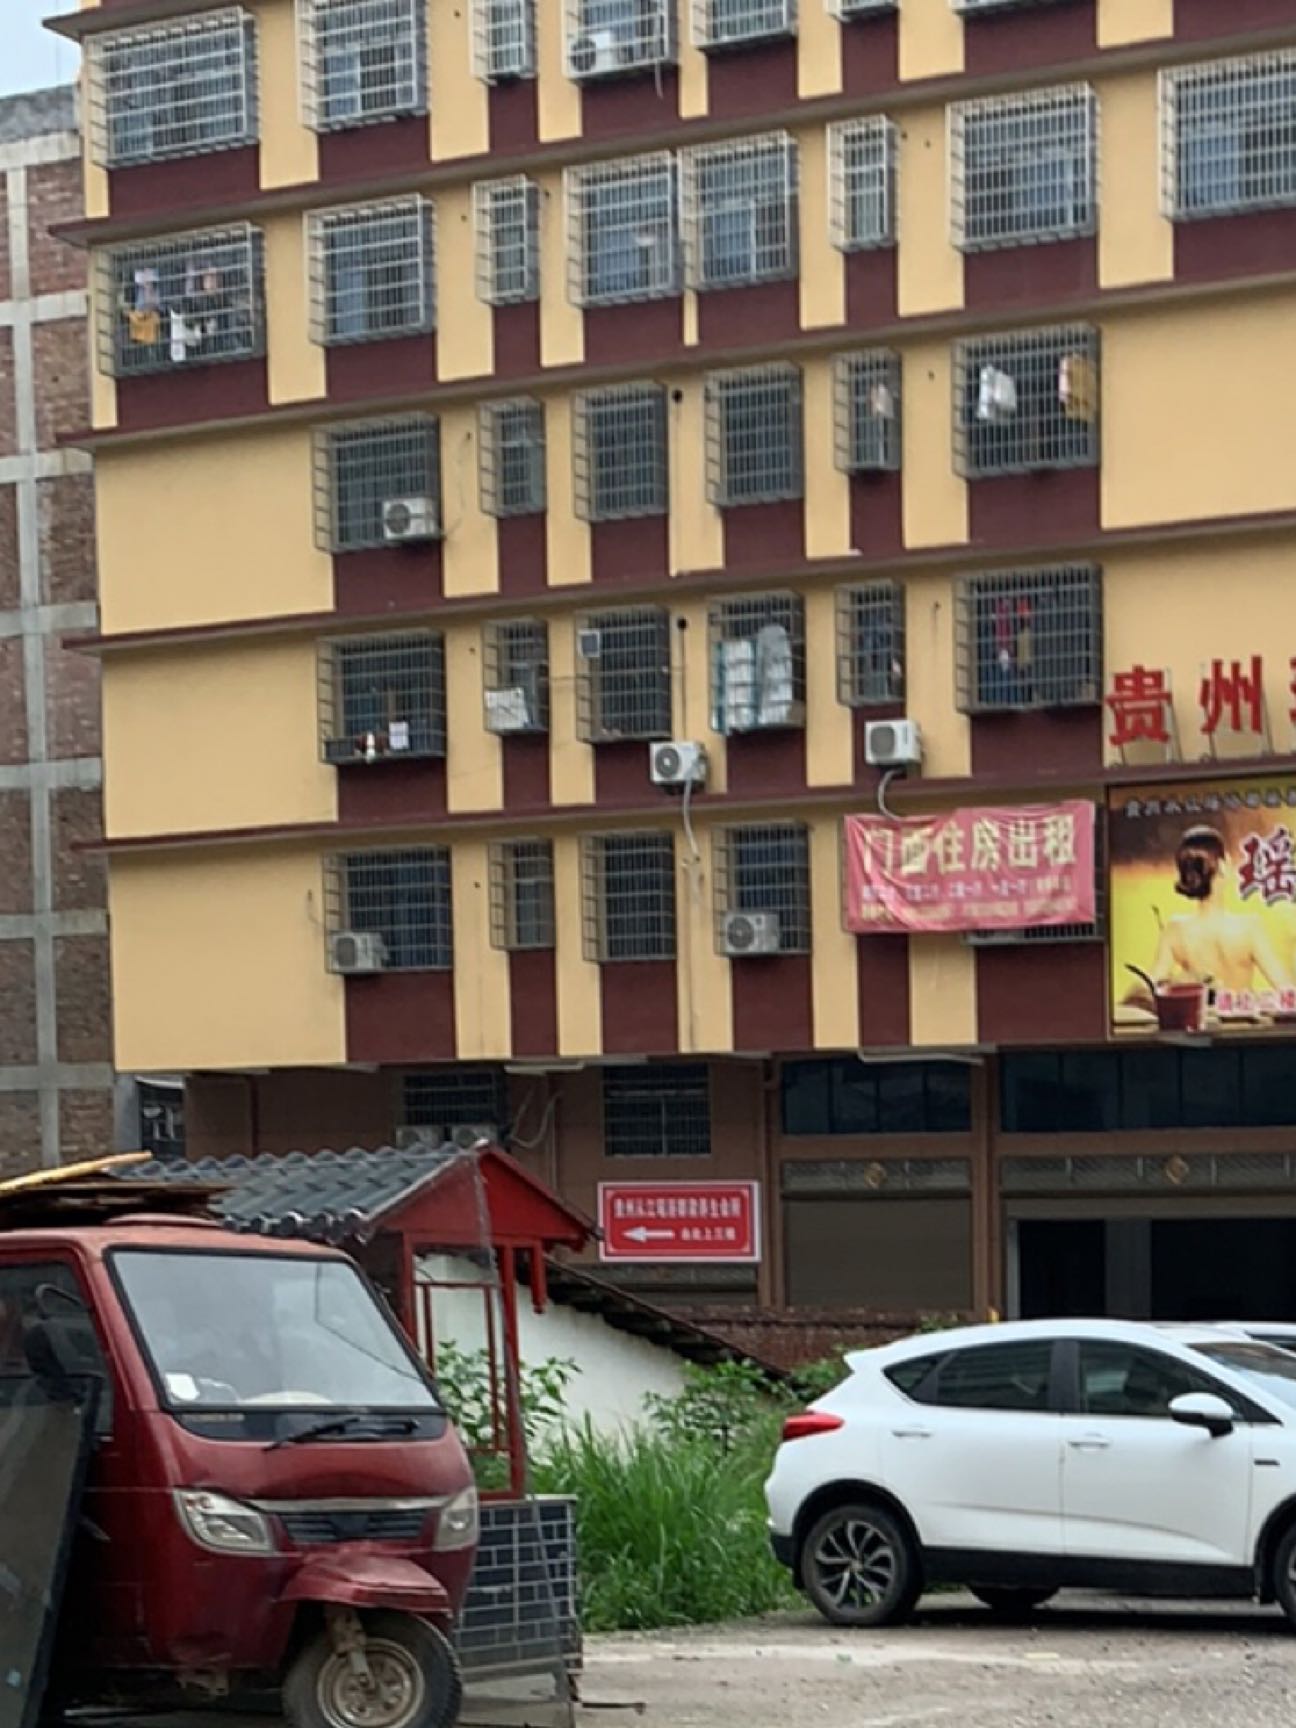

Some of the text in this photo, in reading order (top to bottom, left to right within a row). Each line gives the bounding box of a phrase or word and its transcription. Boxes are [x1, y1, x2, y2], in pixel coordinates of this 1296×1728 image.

[862, 814, 1077, 876] 门面住房出租
